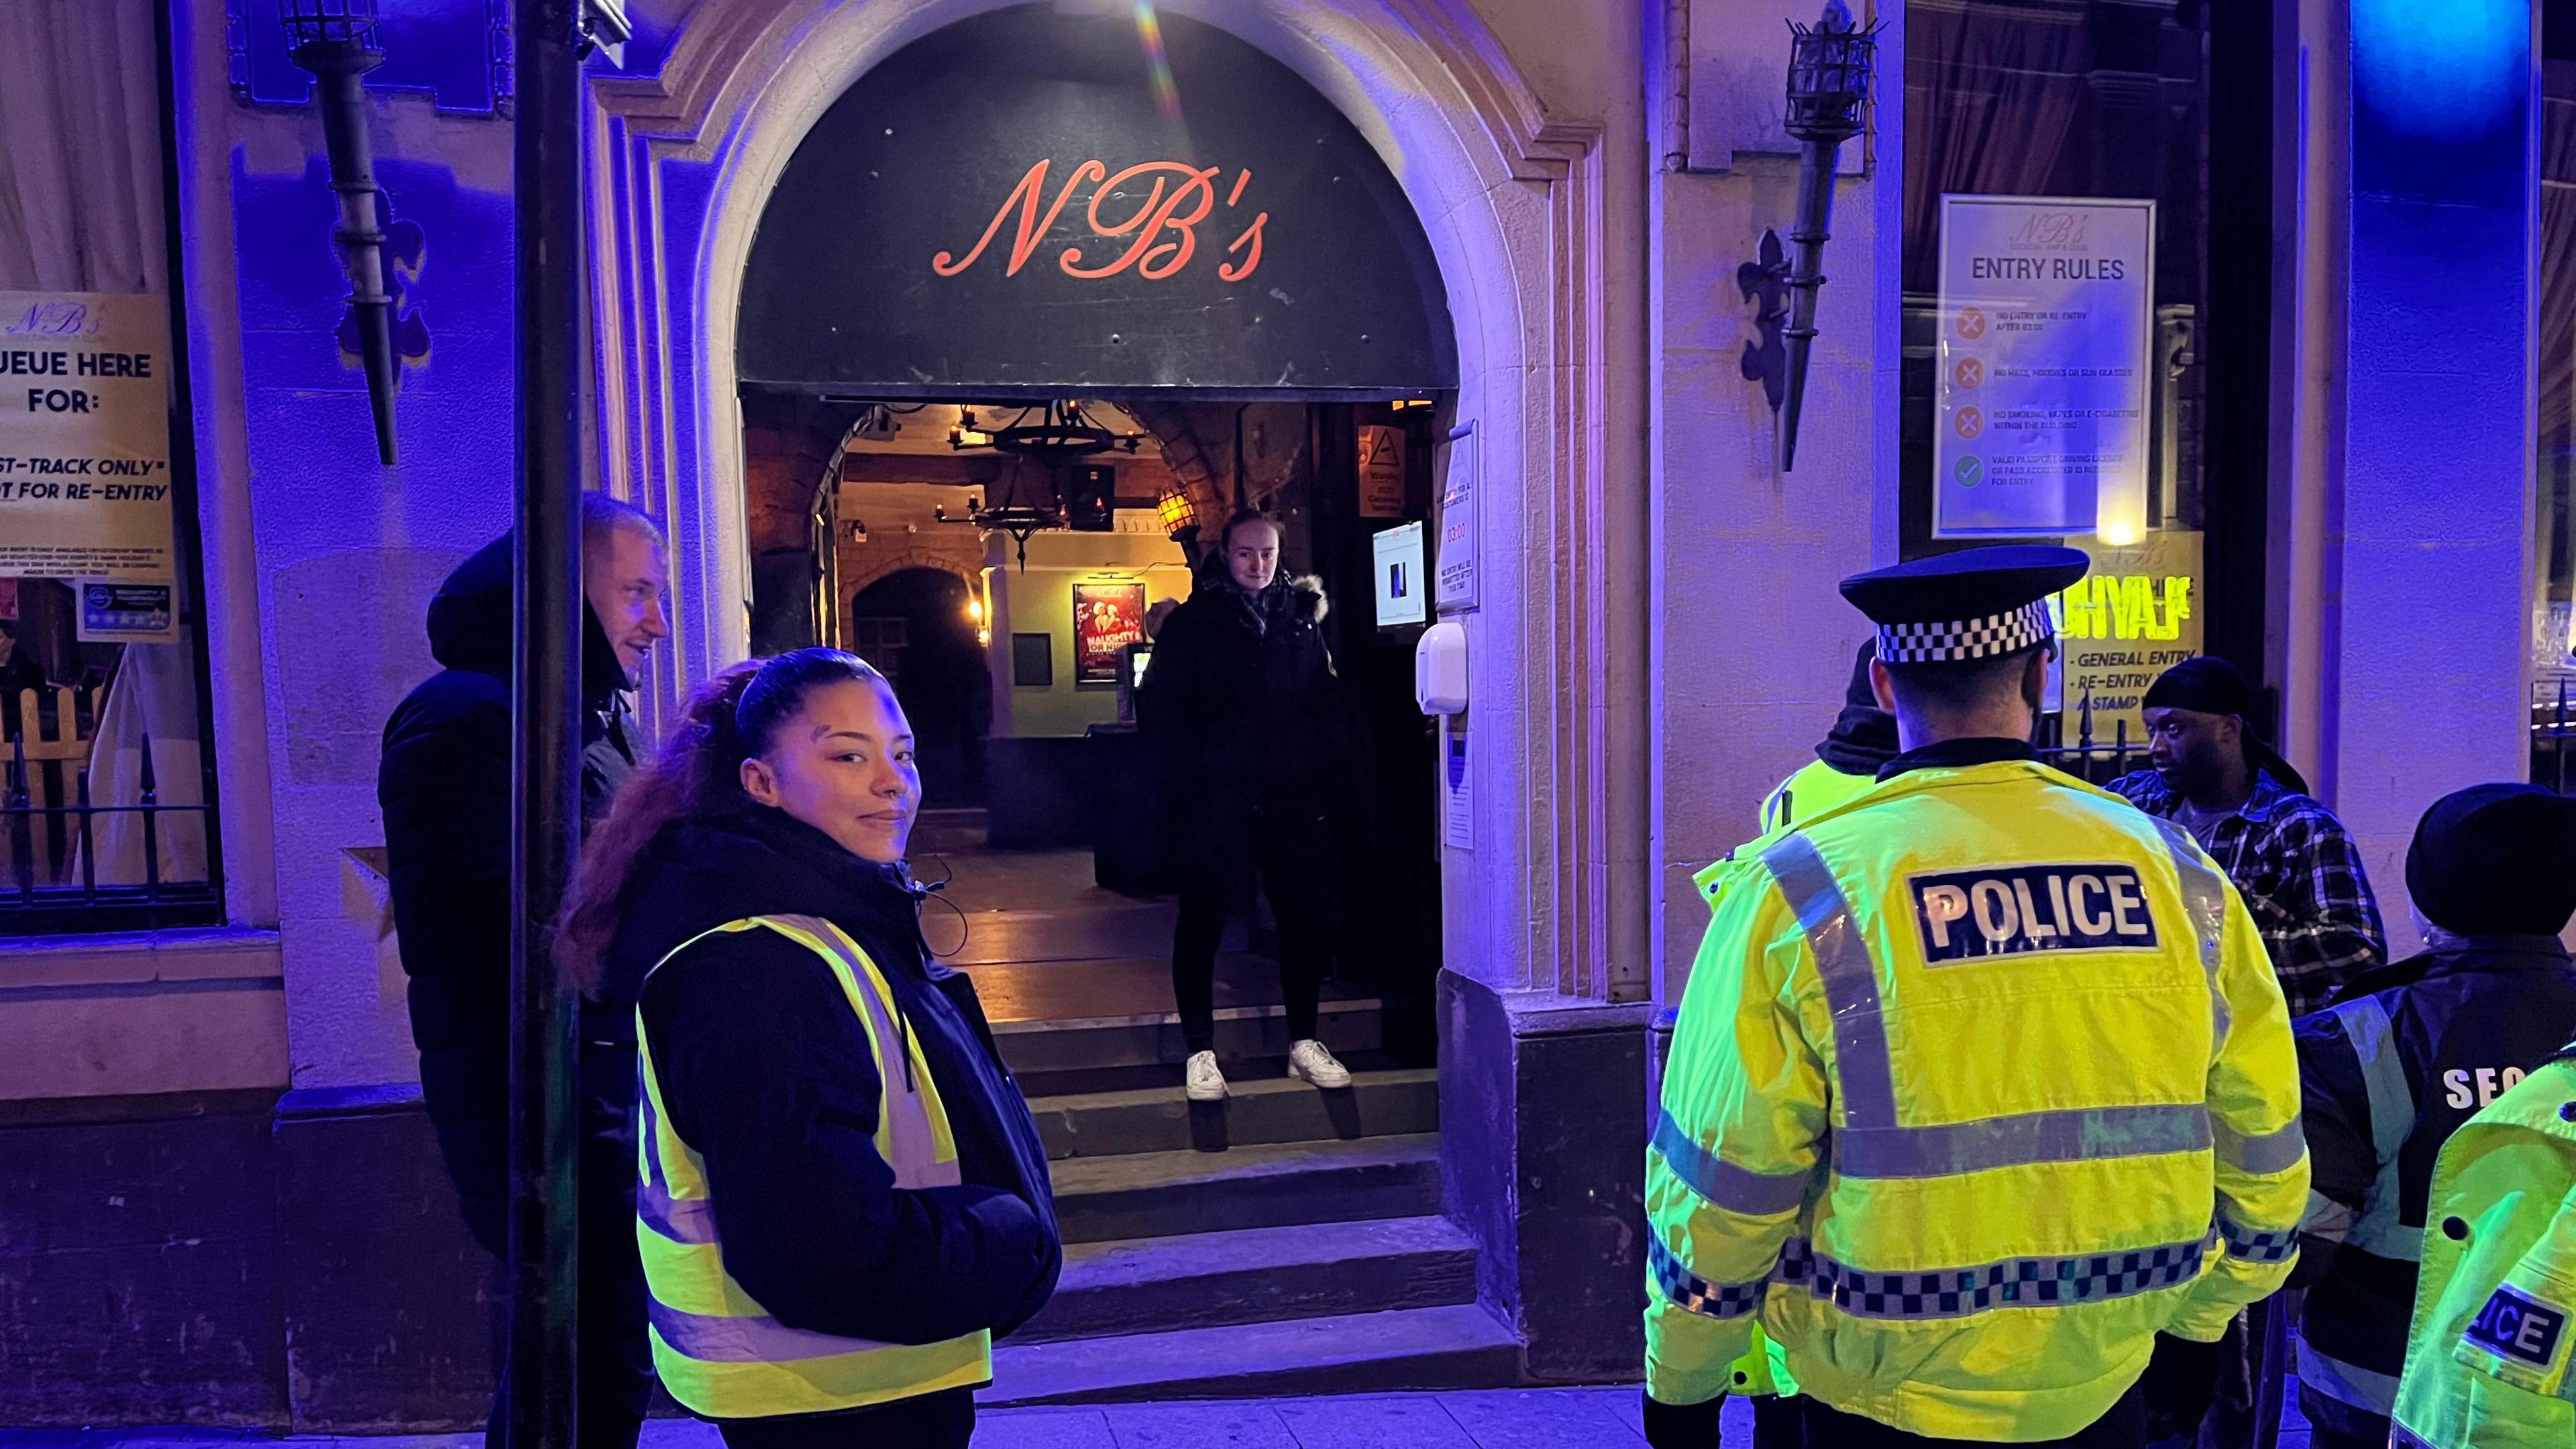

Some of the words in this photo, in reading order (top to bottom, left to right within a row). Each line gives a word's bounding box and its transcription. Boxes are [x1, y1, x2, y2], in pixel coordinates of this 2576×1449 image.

[932, 158, 1268, 282] NB's
[2009, 212, 2088, 244] NB's
[1972, 258, 2045, 279] ENTRY
[2053, 258, 2124, 280] RULES
[2010, 312, 2034, 320] ENTRY
[77, 352, 152, 378] HERE
[28, 388, 99, 413] FOR:
[1994, 411, 2006, 419] NO
[2025, 422, 2040, 430] THE
[0, 482, 13, 499] T
[18, 482, 60, 499] FOR
[66, 483, 168, 501] RE-ENTRY
[1087, 631, 1134, 644] NAUGHTY
[1091, 643, 1104, 651] OR
[2078, 651, 2144, 667] GENERAL
[2149, 649, 2196, 665] ENTRY
[2078, 673, 2152, 690] RE-ENTRY
[2092, 696, 2138, 711] STAMP
[1923, 875, 2148, 948] POLICE
[2471, 1297, 2550, 1354] ICE
